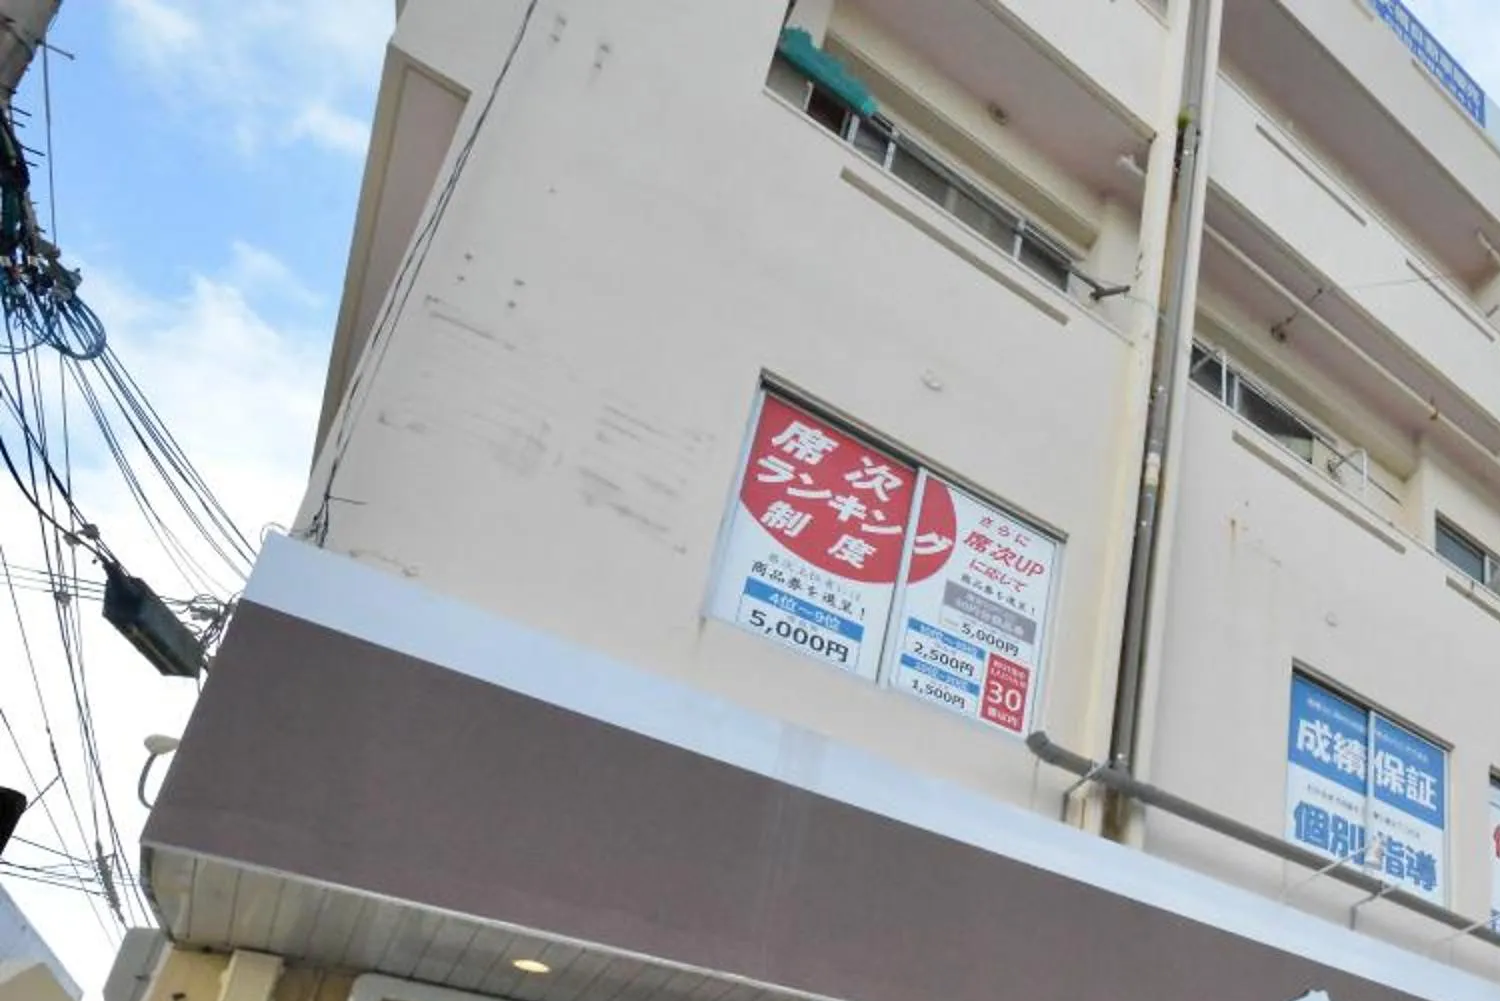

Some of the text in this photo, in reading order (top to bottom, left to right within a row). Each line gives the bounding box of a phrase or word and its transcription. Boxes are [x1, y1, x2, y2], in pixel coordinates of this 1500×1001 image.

[772, 420, 903, 501] 席次
[757, 457, 952, 556] ランキング
[760, 501, 877, 569] 制度
[749, 609, 850, 663] 5,000円
[913, 641, 976, 677] 2,500円
[961, 622, 1020, 657] 5,000円
[1296, 719, 1437, 812] 成績保証
